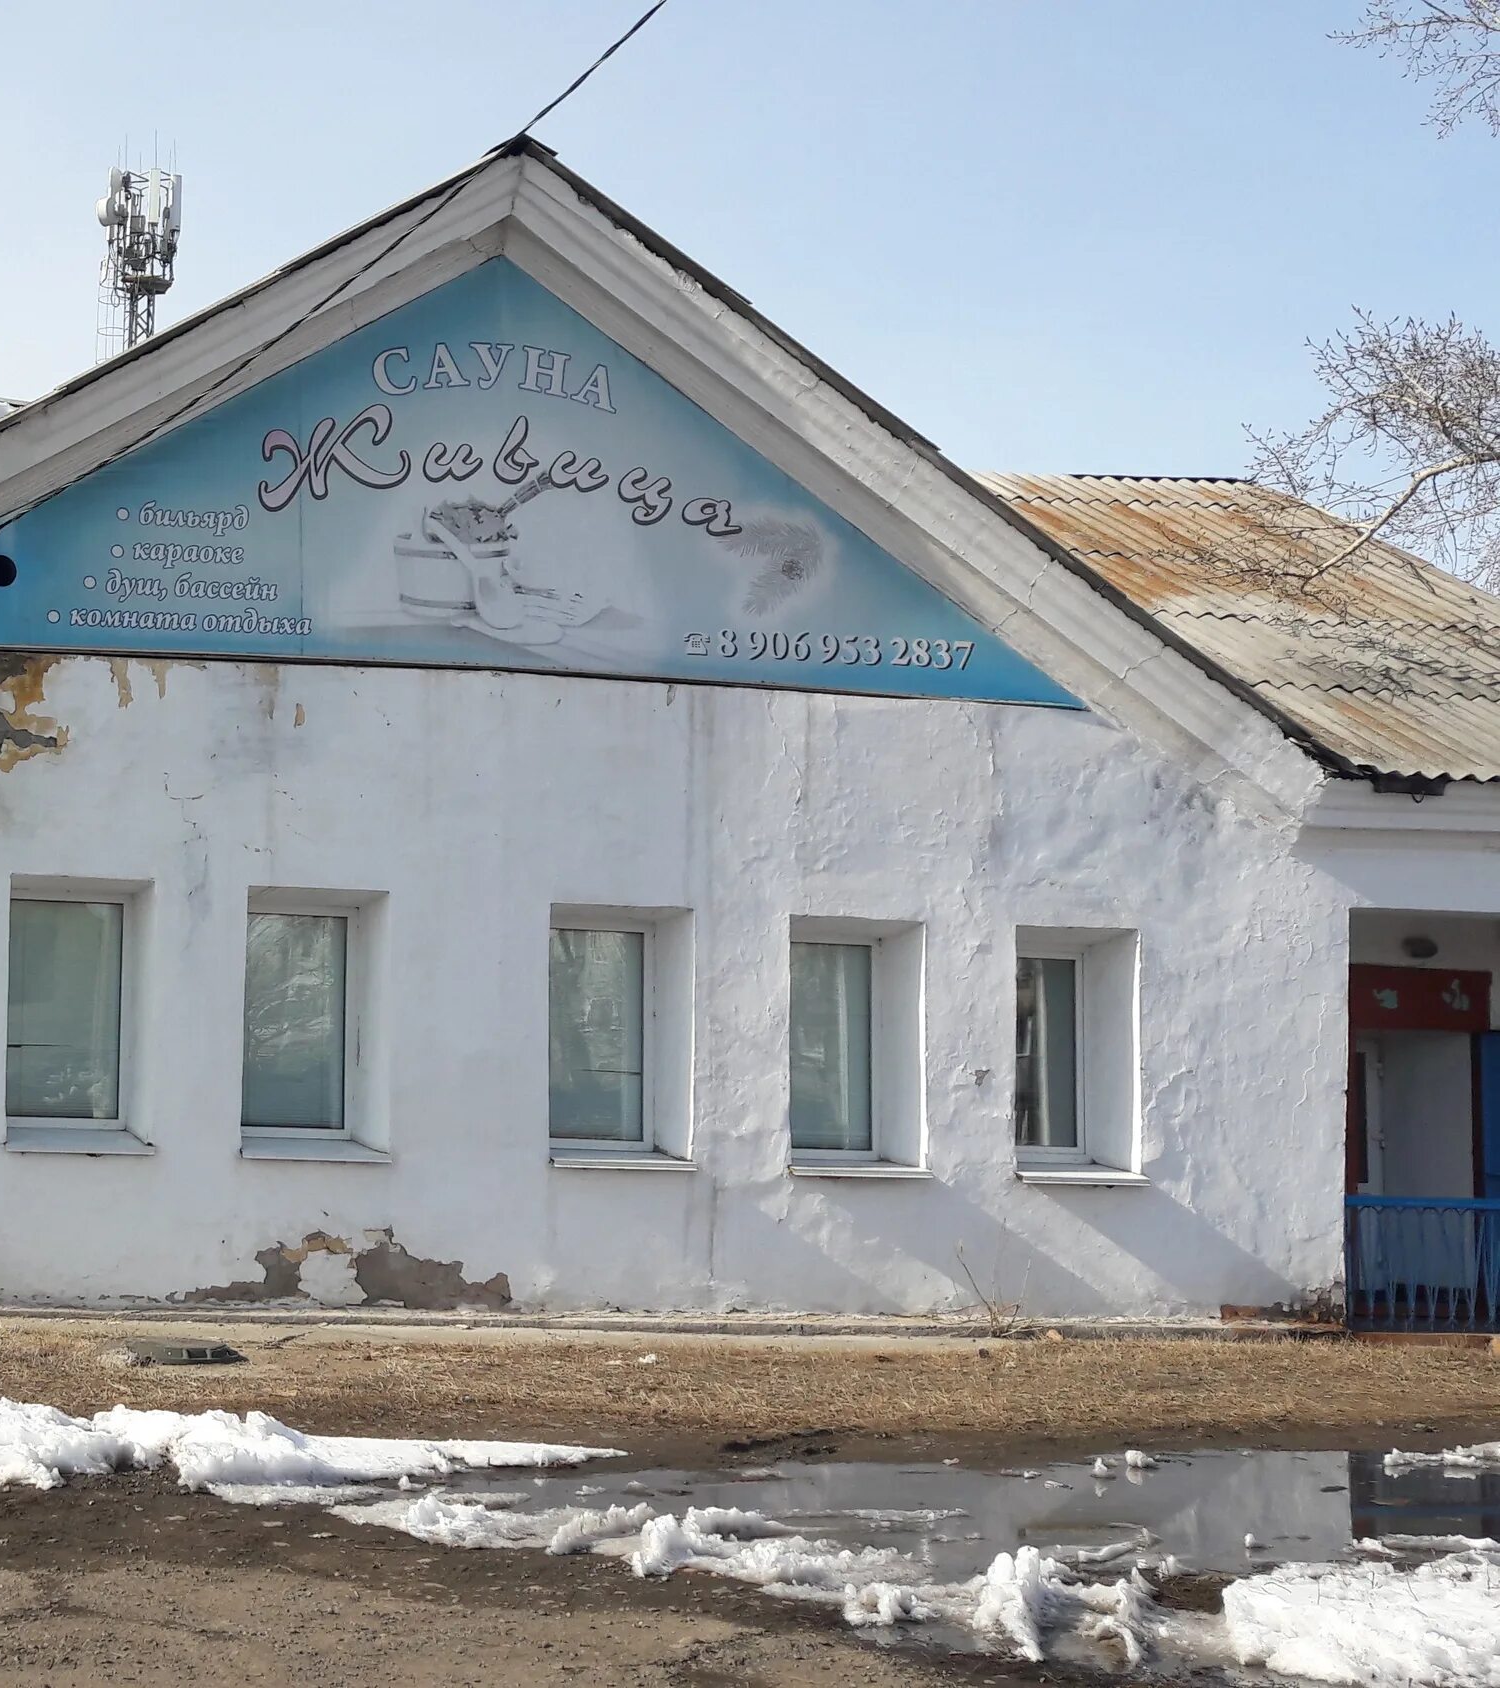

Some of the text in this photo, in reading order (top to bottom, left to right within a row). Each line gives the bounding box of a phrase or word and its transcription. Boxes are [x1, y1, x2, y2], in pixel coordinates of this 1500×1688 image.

[372, 342, 617, 414] САУНА
[258, 403, 743, 536] Живица
[138, 500, 250, 537] бильярд
[132, 541, 245, 569] караоке
[105, 568, 278, 602] душ, бассейн
[69, 607, 313, 636] комната отдыха
[717, 628, 976, 671] 8 906 953 2837
